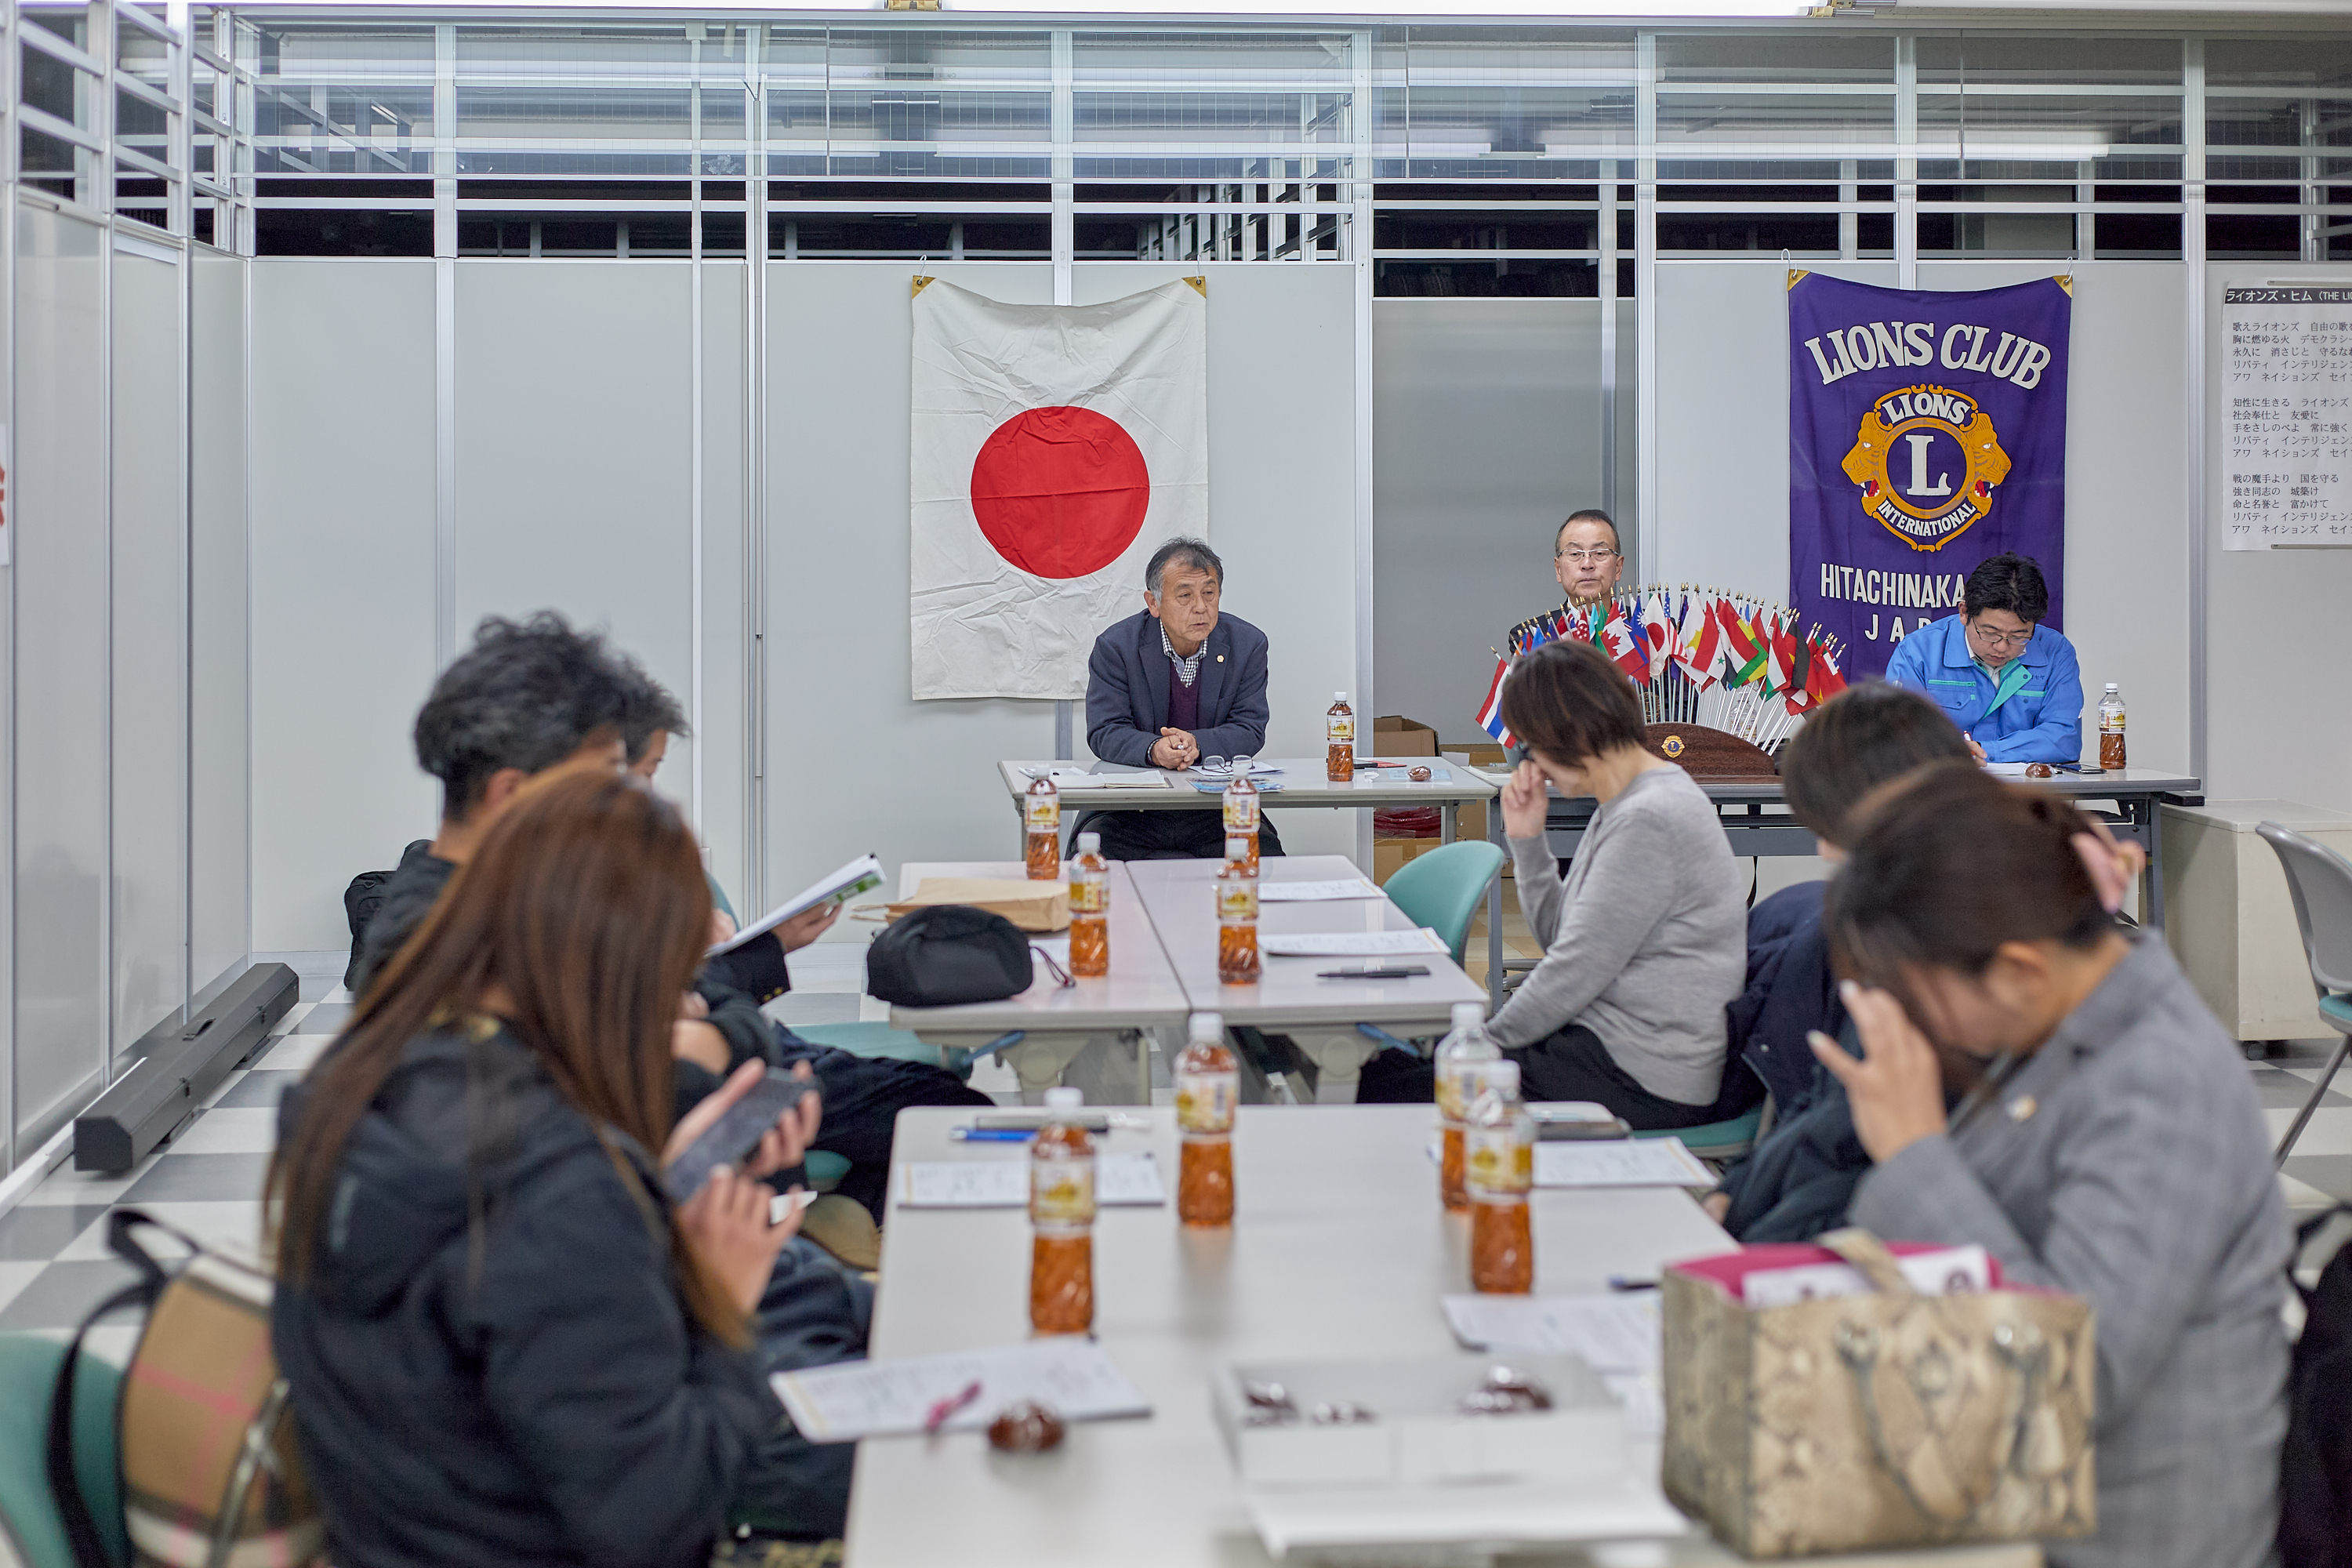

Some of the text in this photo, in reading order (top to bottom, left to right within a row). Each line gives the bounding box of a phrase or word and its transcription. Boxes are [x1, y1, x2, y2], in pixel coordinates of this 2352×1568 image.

[2227, 290, 2312, 302] ライオンズ・ヒム
[2233, 321, 2299, 332] 歌えライオンズ
[2233, 335, 2290, 344] 胸に燃ゆる火
[1804, 321, 2052, 390] LIONS CLUB
[2233, 347, 2260, 357] 永久に
[2271, 347, 2310, 357] 消さじと
[2234, 361, 2269, 369] リバティ
[2233, 372, 2352, 382] アワ ネイションズ セイ
[2233, 397, 2349, 408] 知性に生きる ライオンズ
[1882, 393, 1971, 424] LIONS
[2233, 411, 2319, 420] 社会奉仕と 友愛に
[2233, 423, 2347, 432] 手をさしのべよ 常に強く
[2234, 436, 2269, 445] リバティ
[2233, 448, 2352, 458] アワ ネイションズ セイ
[1906, 435, 1951, 496] L
[2233, 474, 2339, 484] 戦の魔手より 国を守る
[2233, 487, 2319, 496] 強き同志の 城築け
[2233, 499, 2329, 509] 命と名誉と 富かけて
[1878, 499, 1977, 537] INTERNATIONAL
[2234, 513, 2269, 521] リバティ
[2233, 525, 2352, 534] アワ ネイションズ セイ
[1820, 563, 1965, 608] HITACHINAKA
